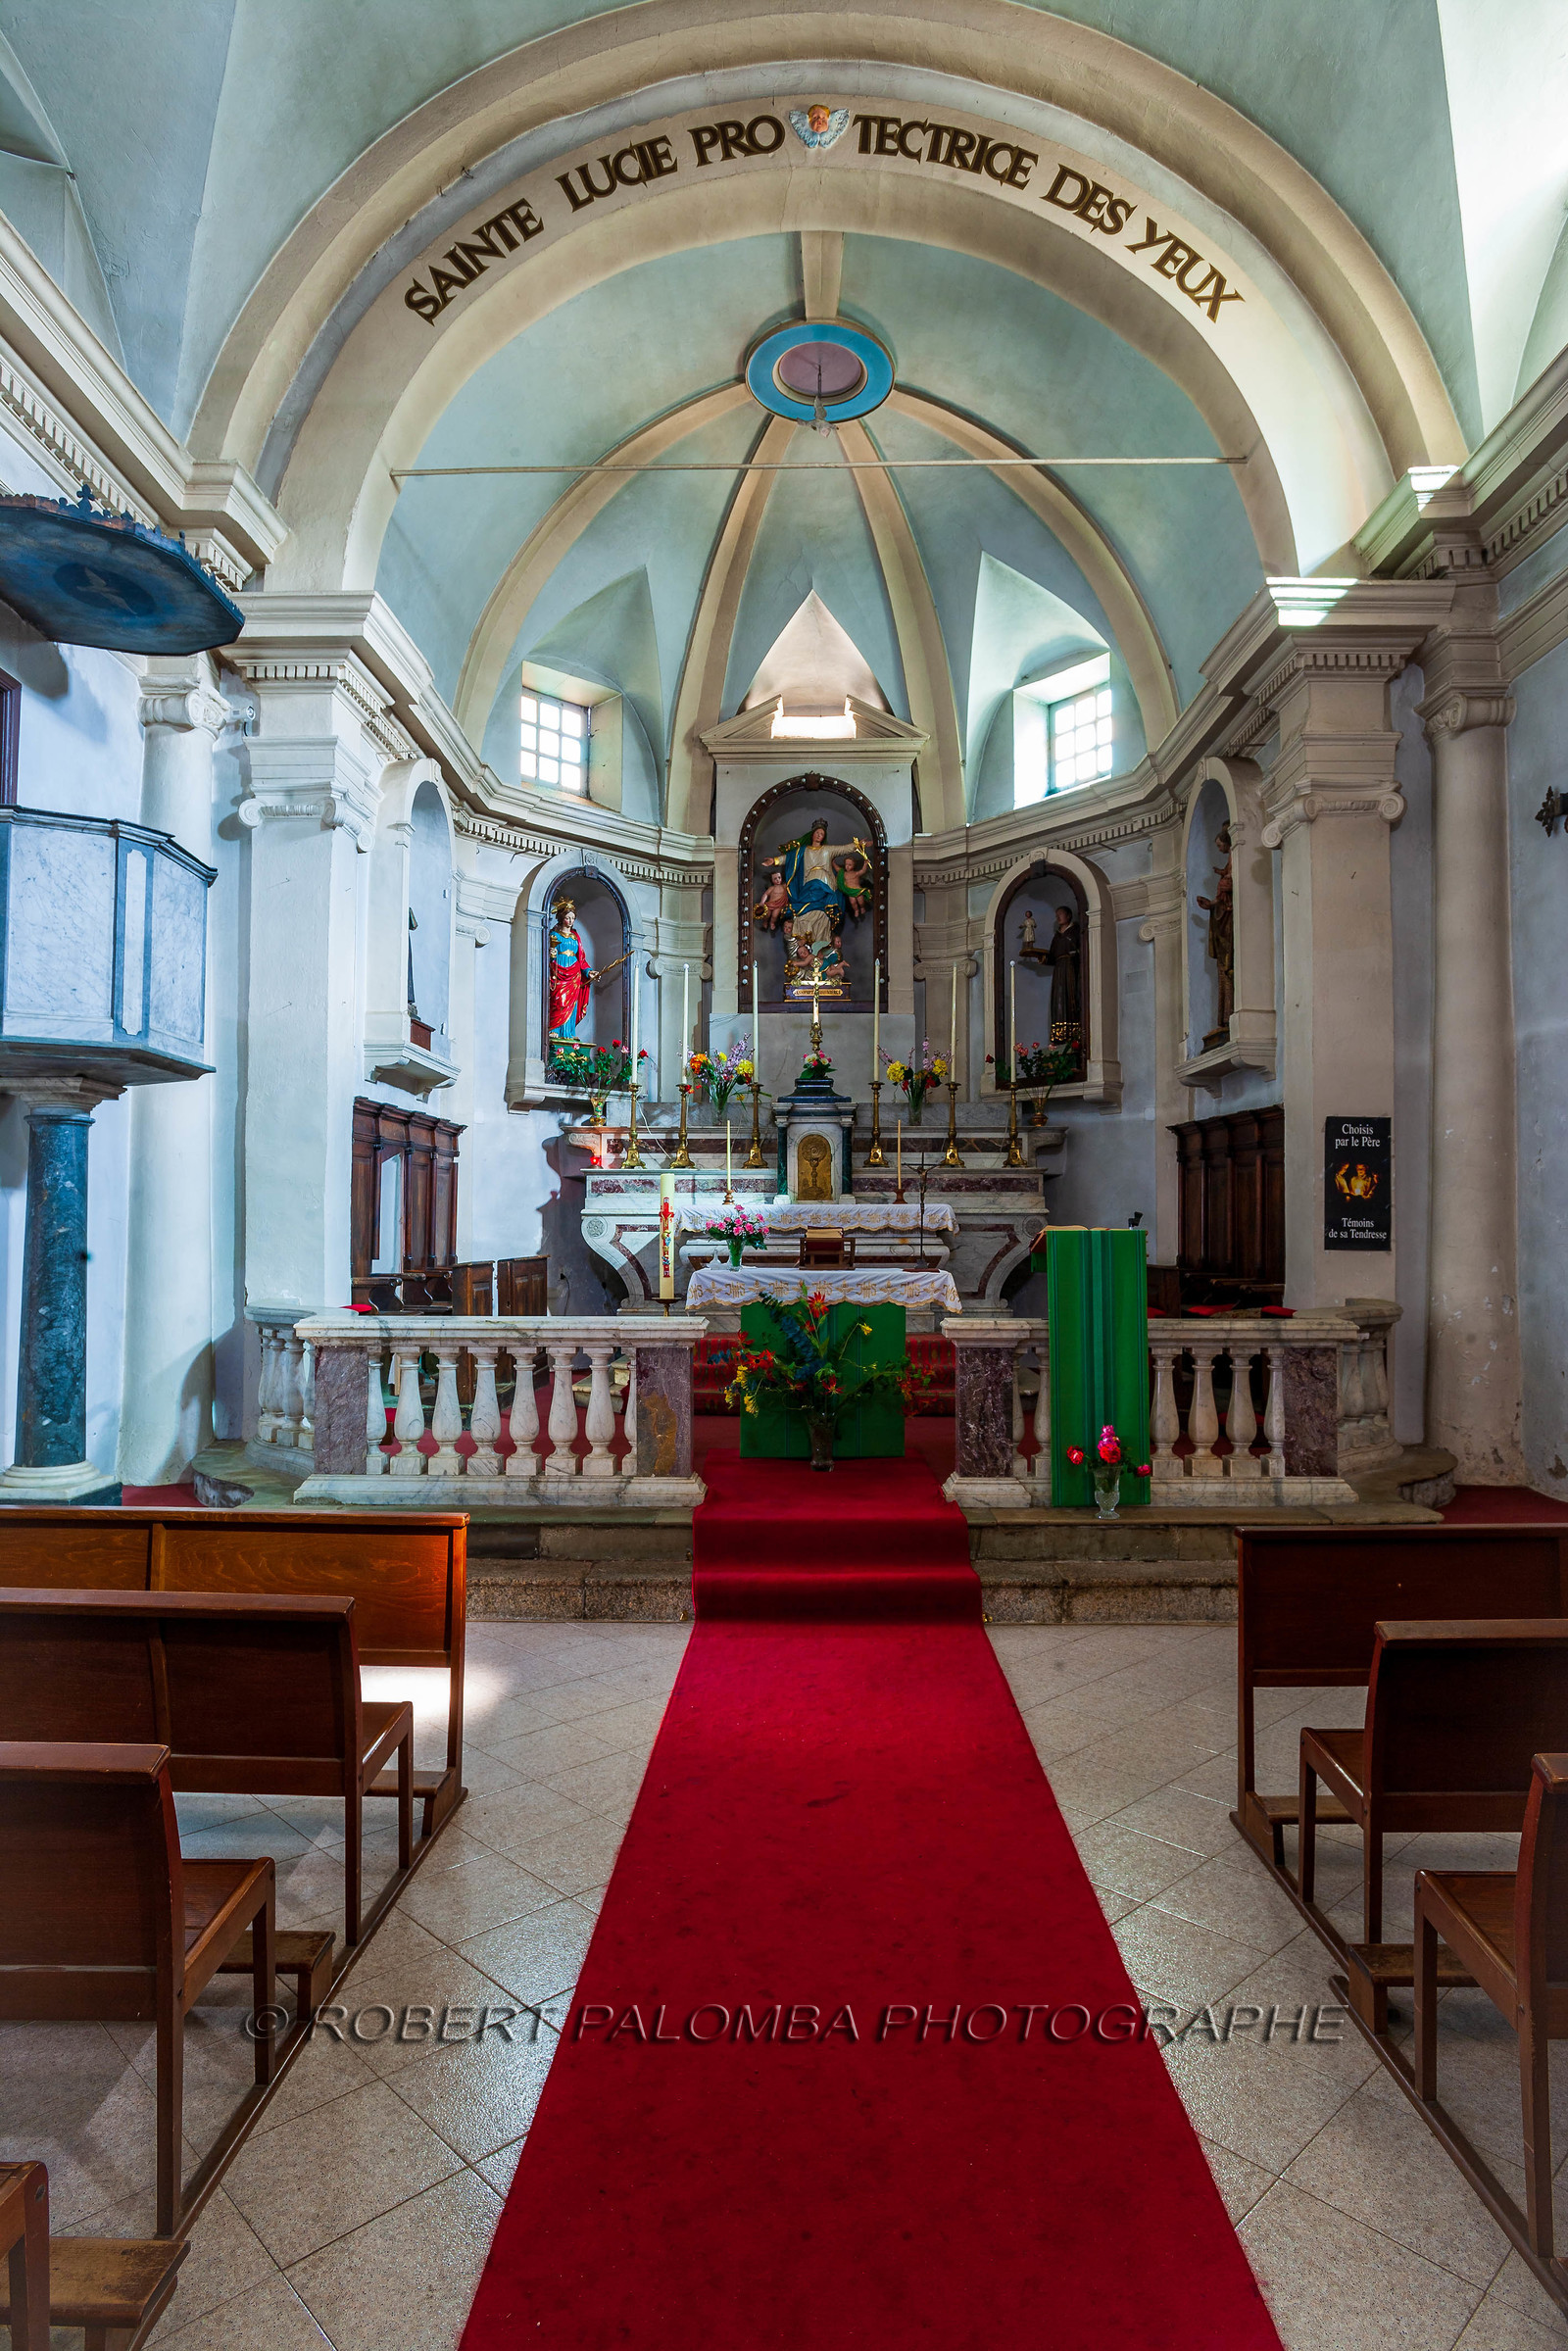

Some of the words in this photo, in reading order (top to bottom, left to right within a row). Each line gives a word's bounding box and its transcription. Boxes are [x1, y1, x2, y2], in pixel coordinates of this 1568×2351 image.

[404, 197, 545, 327] SAINTE
[554, 135, 679, 214] LUCIE
[686, 113, 786, 168] PRO
[852, 114, 1040, 192] TECTRICE
[1040, 162, 1139, 235] DES
[1124, 216, 1247, 324] YEUX
[1342, 1123, 1374, 1135] Choisis
[1335, 1138, 1349, 1150] par
[1351, 1136, 1359, 1147] le
[1361, 1136, 1381, 1148] Père
[1342, 1217, 1375, 1228] Témoins
[1328, 1228, 1339, 1239] de
[1349, 1228, 1388, 1240] Tendresse
